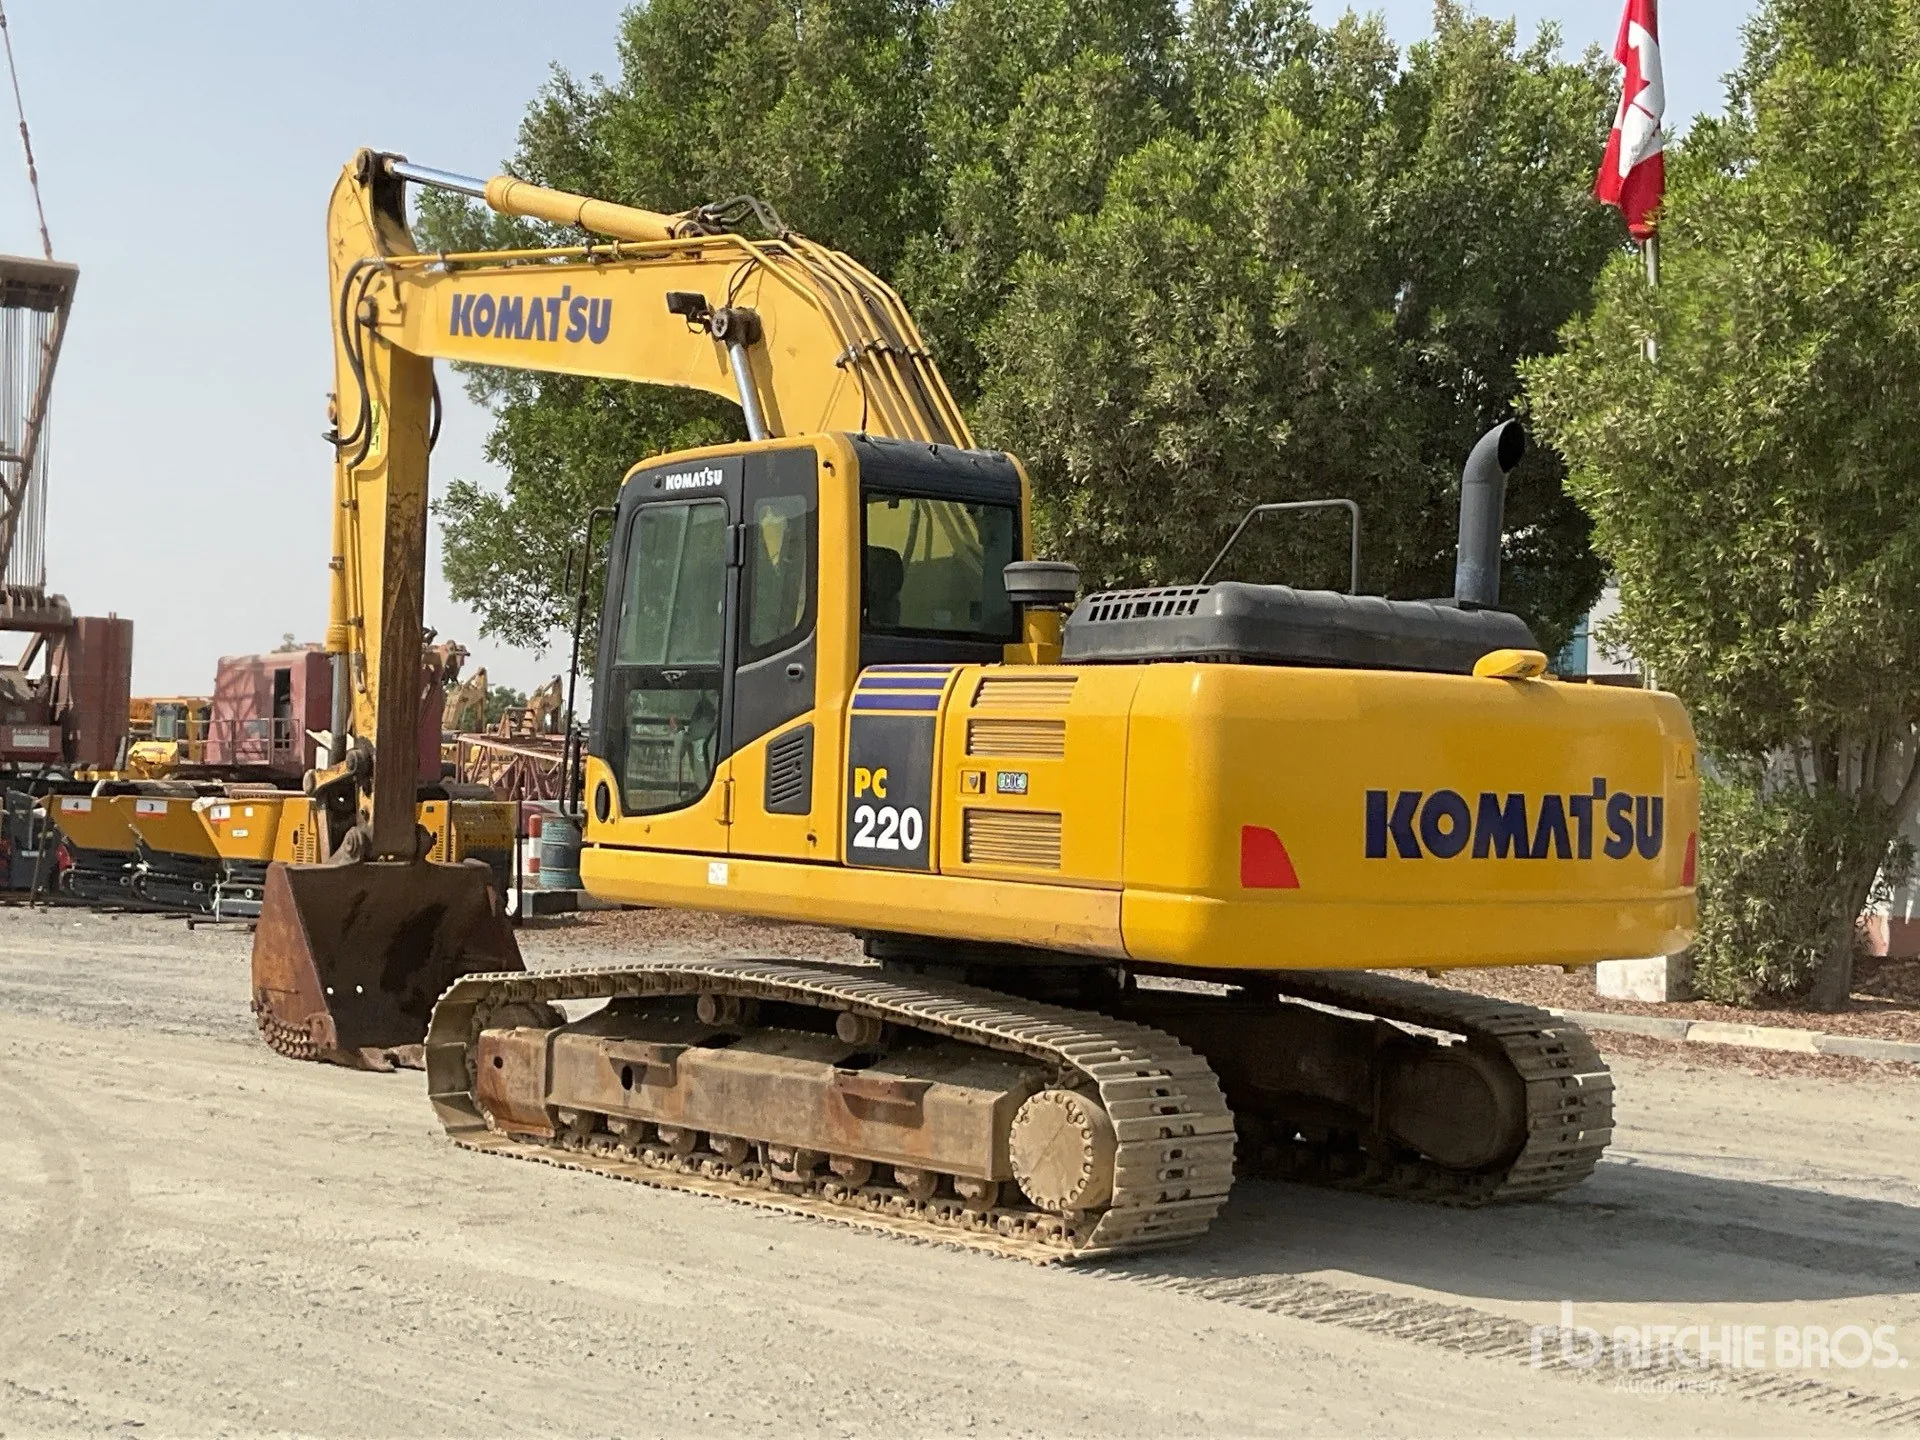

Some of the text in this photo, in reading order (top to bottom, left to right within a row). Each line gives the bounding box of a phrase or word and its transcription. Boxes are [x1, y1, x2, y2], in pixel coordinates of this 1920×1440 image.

[450, 285, 612, 344] KOMATSU
[665, 466, 723, 490] KOMATSU
[854, 767, 888, 798] PC
[853, 805, 923, 850] 220
[1365, 777, 1664, 860] KOMATSU
